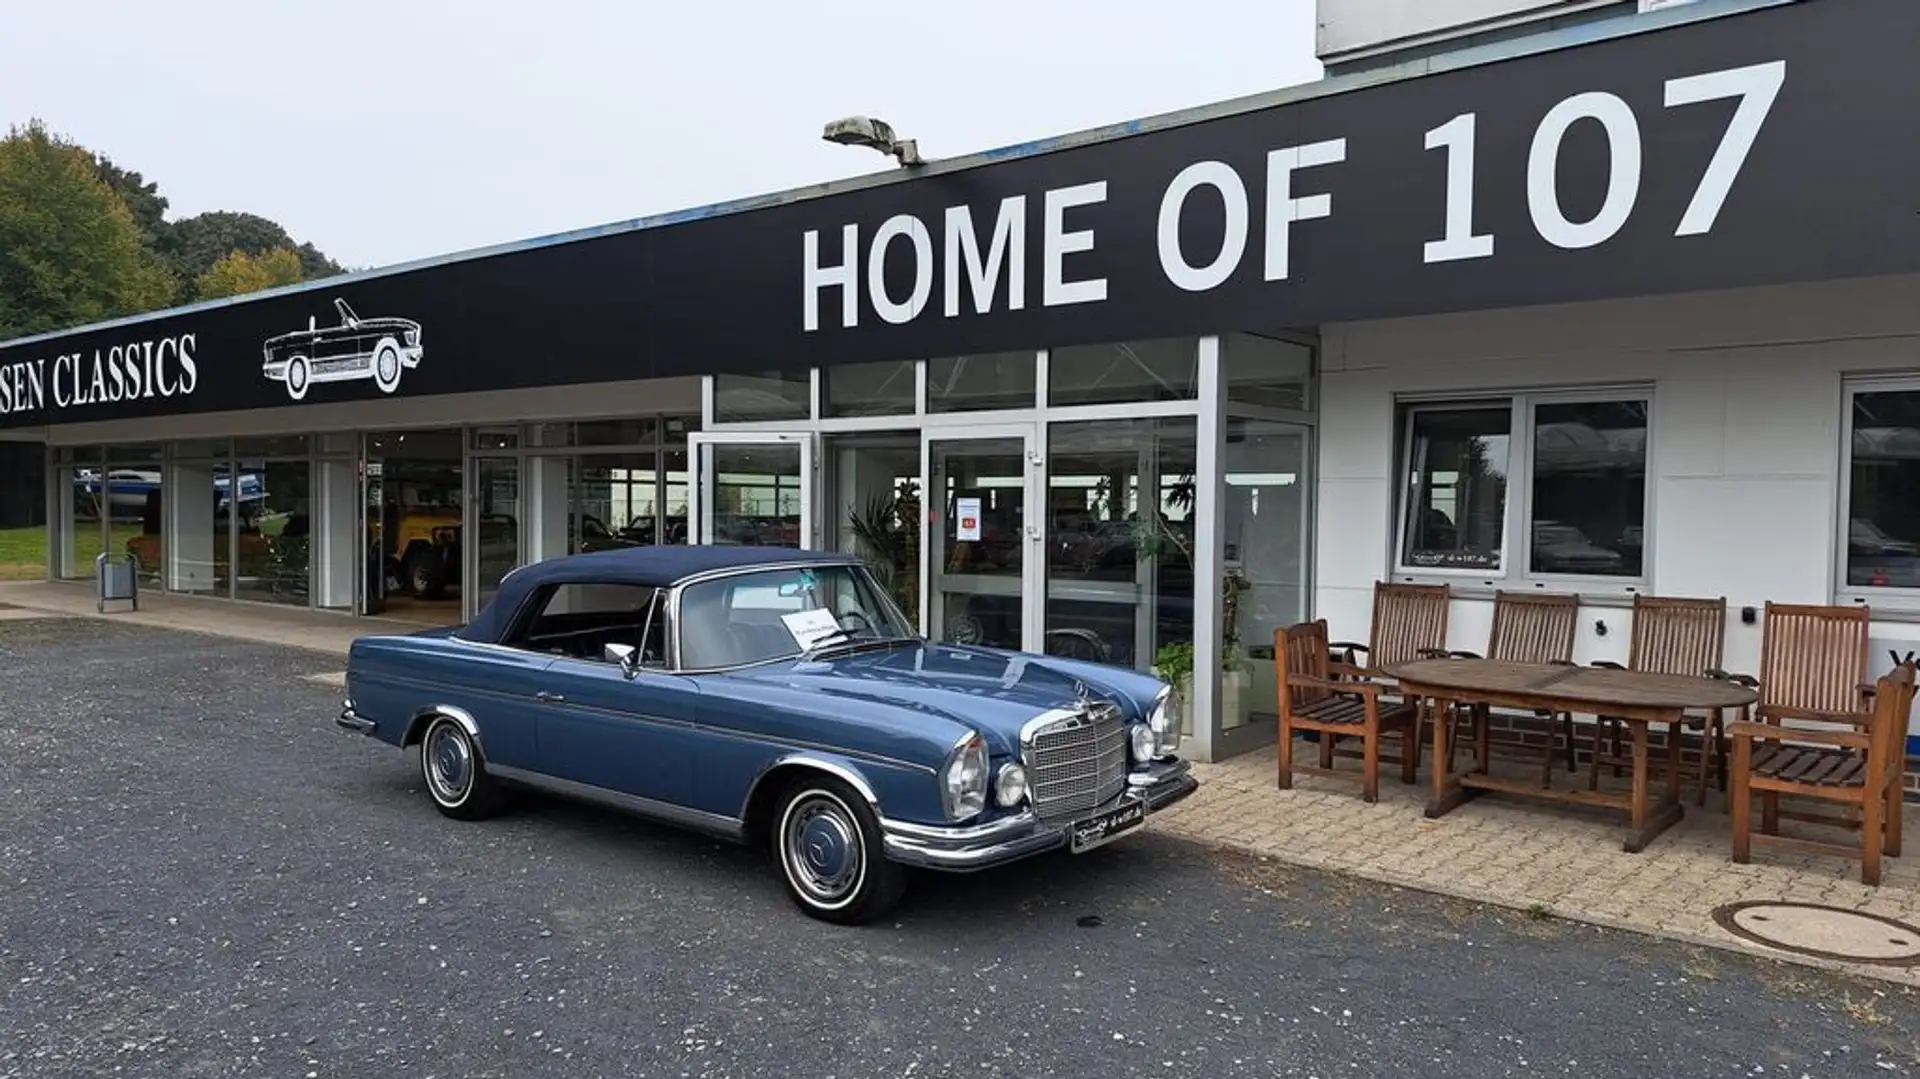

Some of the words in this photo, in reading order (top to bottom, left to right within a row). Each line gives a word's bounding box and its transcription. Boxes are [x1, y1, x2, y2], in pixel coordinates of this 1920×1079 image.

[802, 179, 1108, 332] HOME
[1157, 137, 1347, 291] OF
[1423, 59, 1787, 264] 107
[52, 333, 198, 407] CLASSICS
